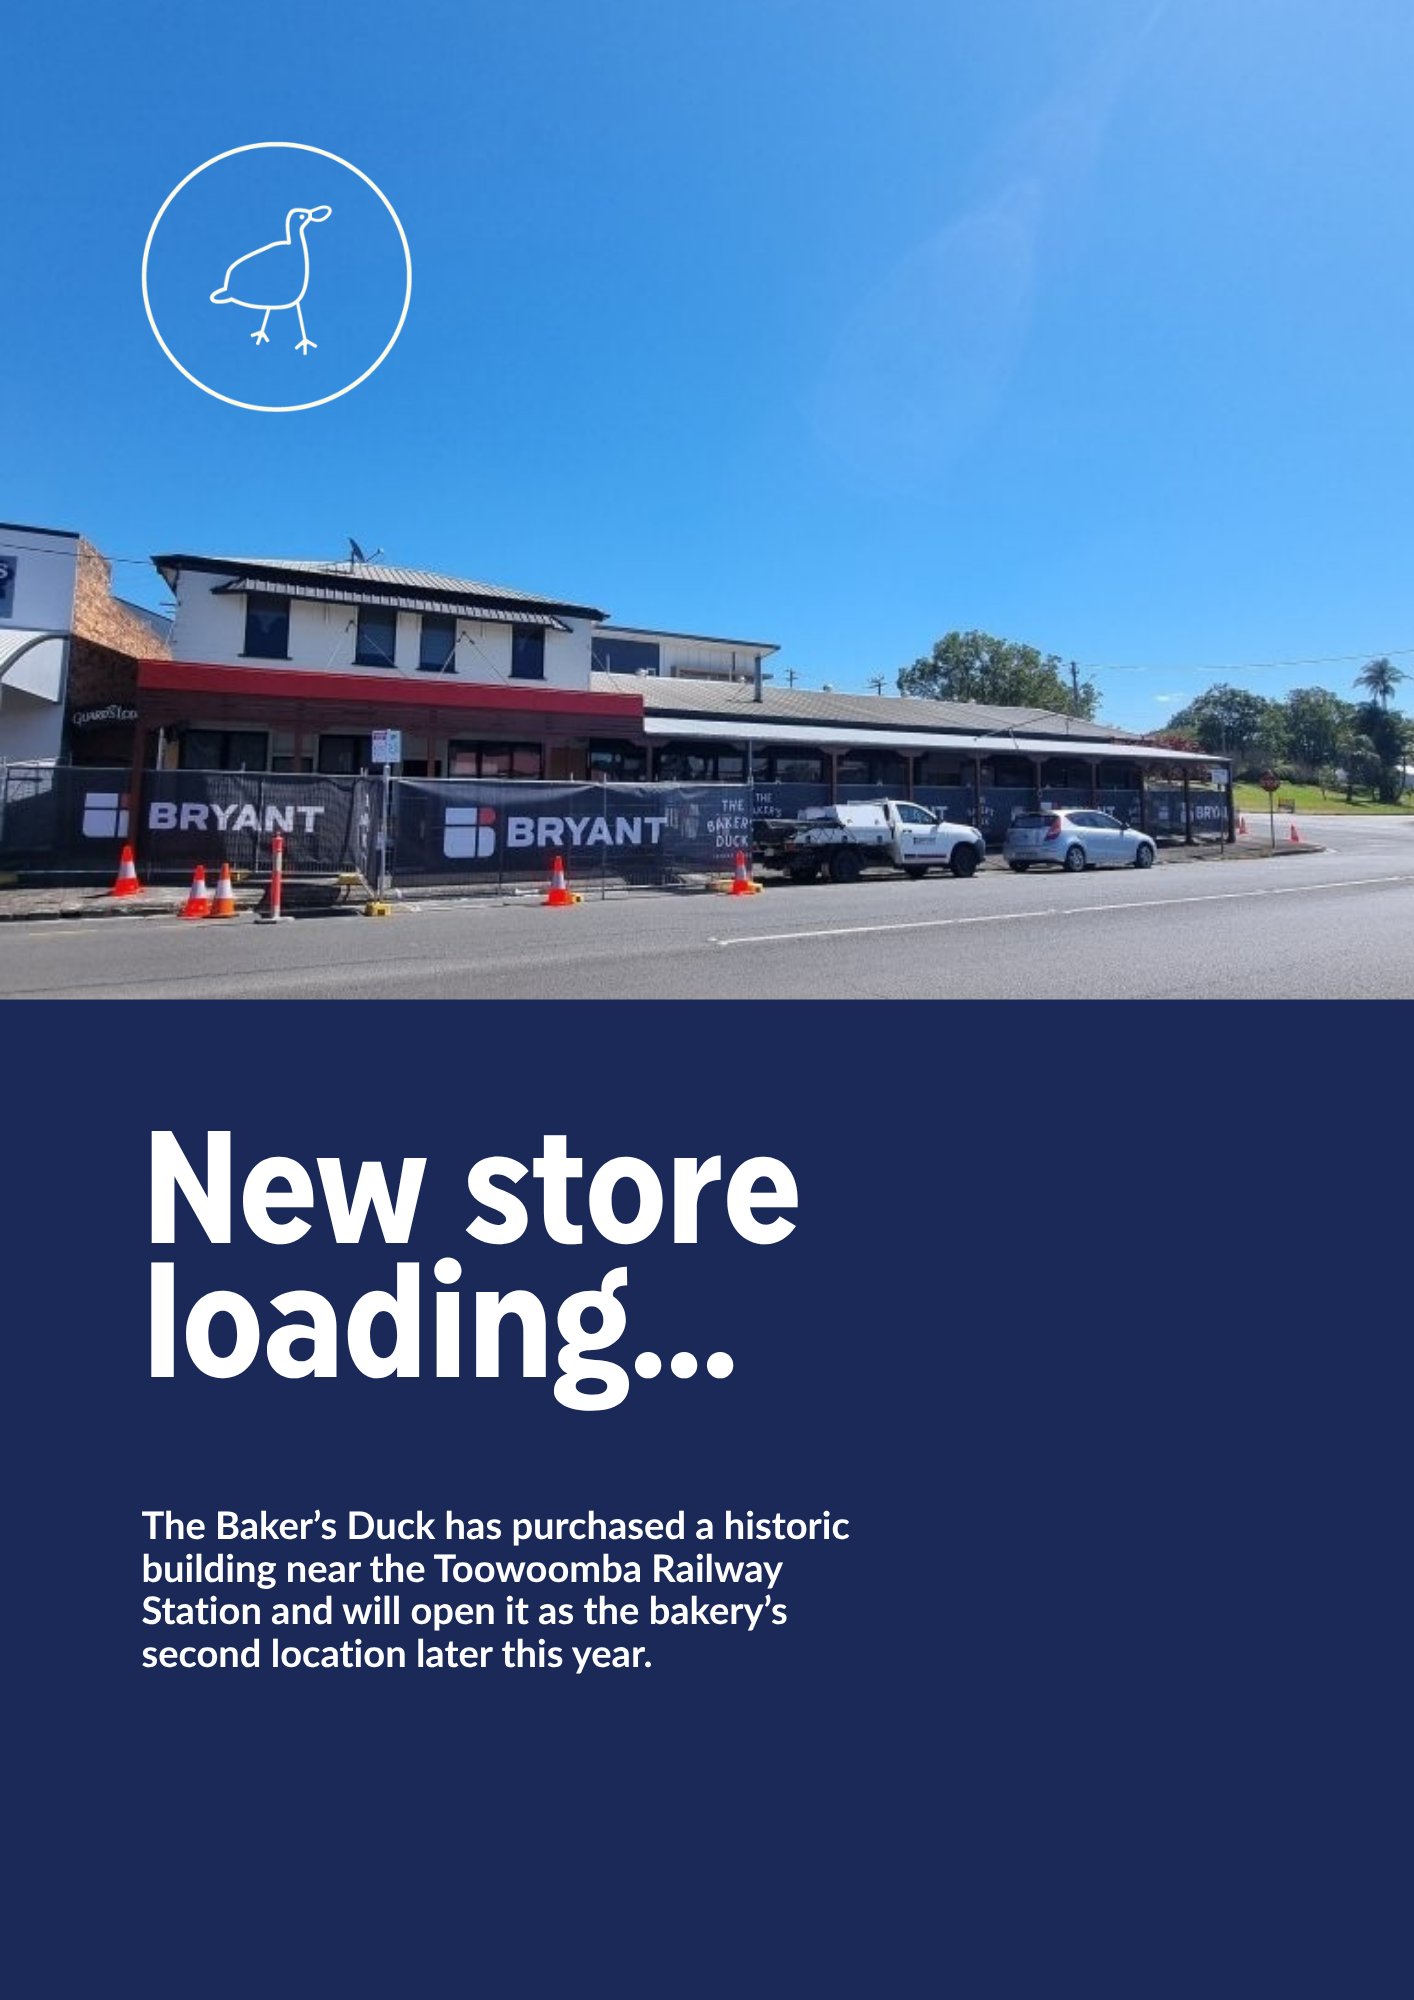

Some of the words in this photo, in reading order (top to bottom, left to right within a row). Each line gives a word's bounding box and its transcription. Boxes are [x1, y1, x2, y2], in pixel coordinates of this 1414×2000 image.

[755, 793, 773, 803] THE
[721, 799, 745, 812] THE
[148, 802, 325, 833] BRYANT
[506, 816, 668, 847] BRYANT
[715, 835, 749, 848] DUCK
